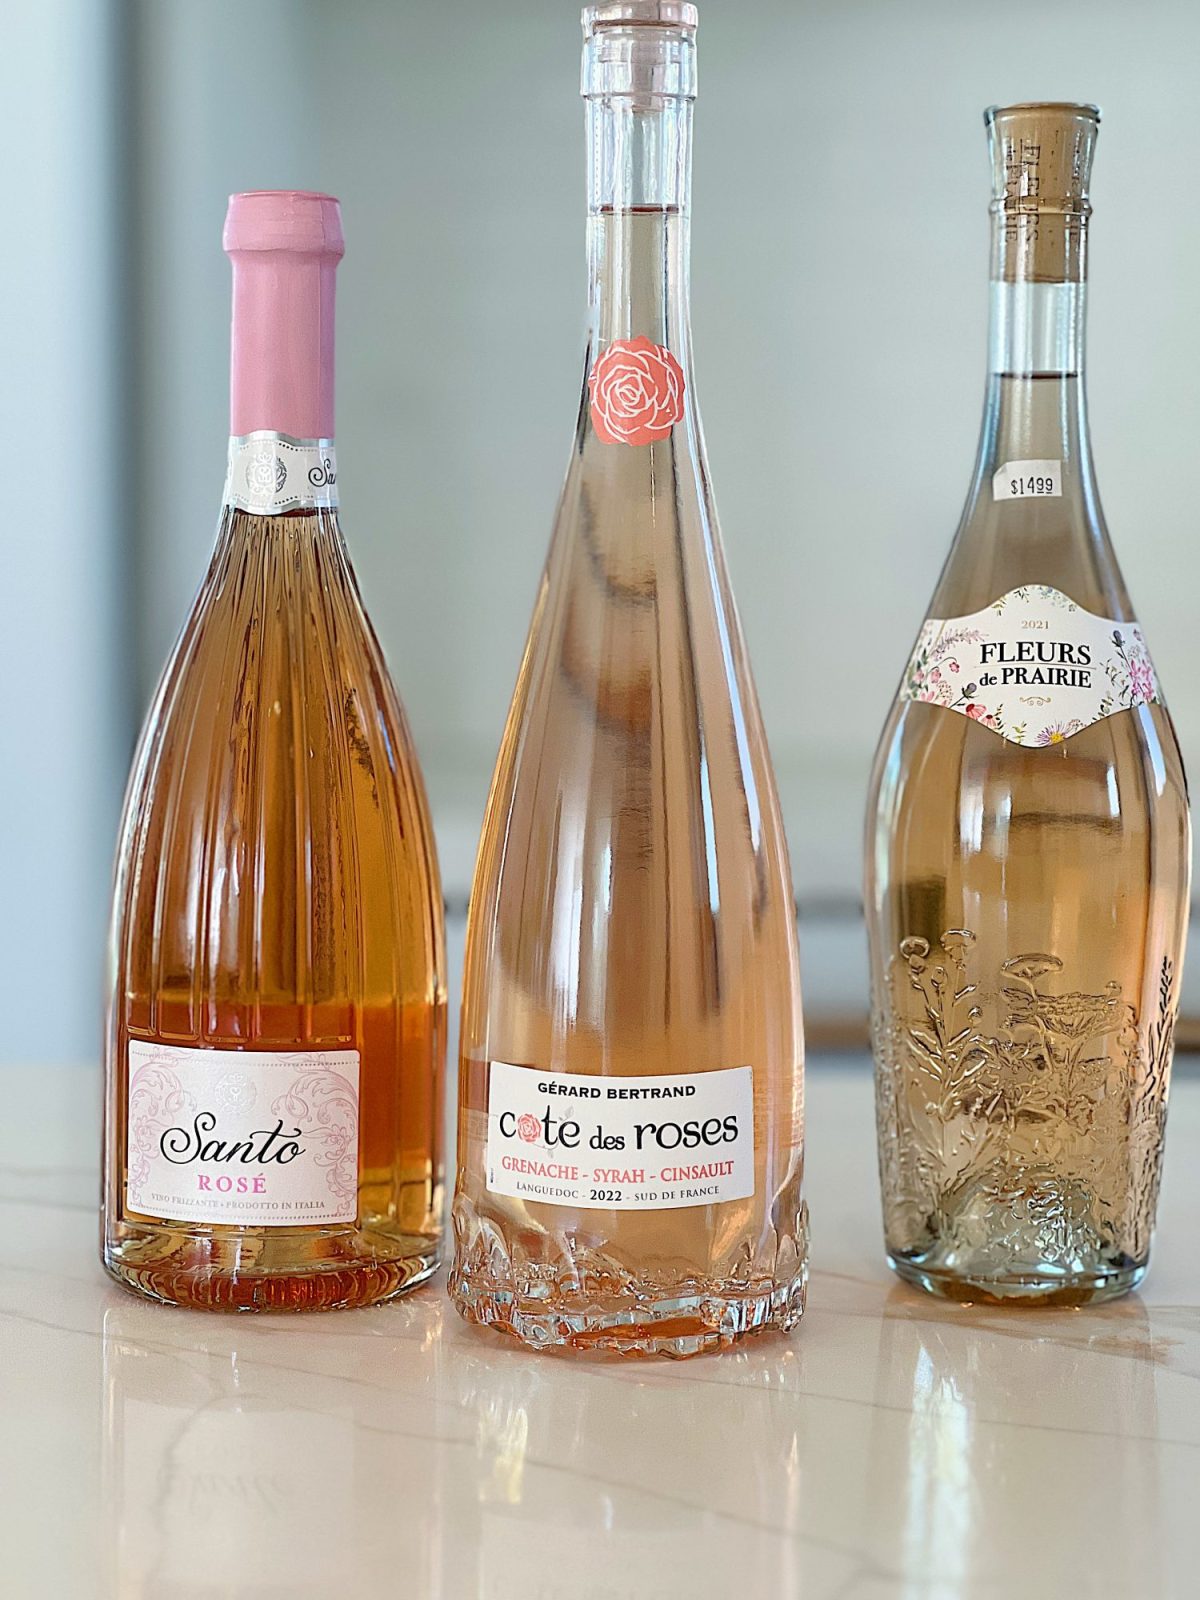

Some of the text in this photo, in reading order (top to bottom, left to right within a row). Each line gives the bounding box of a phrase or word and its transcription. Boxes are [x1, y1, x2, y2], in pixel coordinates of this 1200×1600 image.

[1021, 620, 1049, 629] 2021
[980, 641, 1091, 665] FLEURS
[980, 668, 1092, 688] de PRAIRIE
[538, 1081, 696, 1099] GÉRARD BERTRAND
[160, 1112, 306, 1164] Santo
[589, 1125, 625, 1150] des
[633, 1115, 739, 1150] roses
[502, 1156, 578, 1180] GRENACHE
[593, 1169, 644, 1183] SYRAH
[661, 1161, 734, 1182] CINSAULT
[197, 1173, 267, 1193] ROSÉ
[517, 1182, 578, 1198] LANGUEDOC
[590, 1189, 622, 1201] 2022
[635, 1193, 657, 1201] SUD
[662, 1190, 675, 1200] DE
[680, 1186, 719, 1198] FRANCE
[152, 1193, 170, 1201] VINO
[172, 1196, 219, 1208] FRIZZANTE
[295, 1201, 325, 1209] ITALIA
